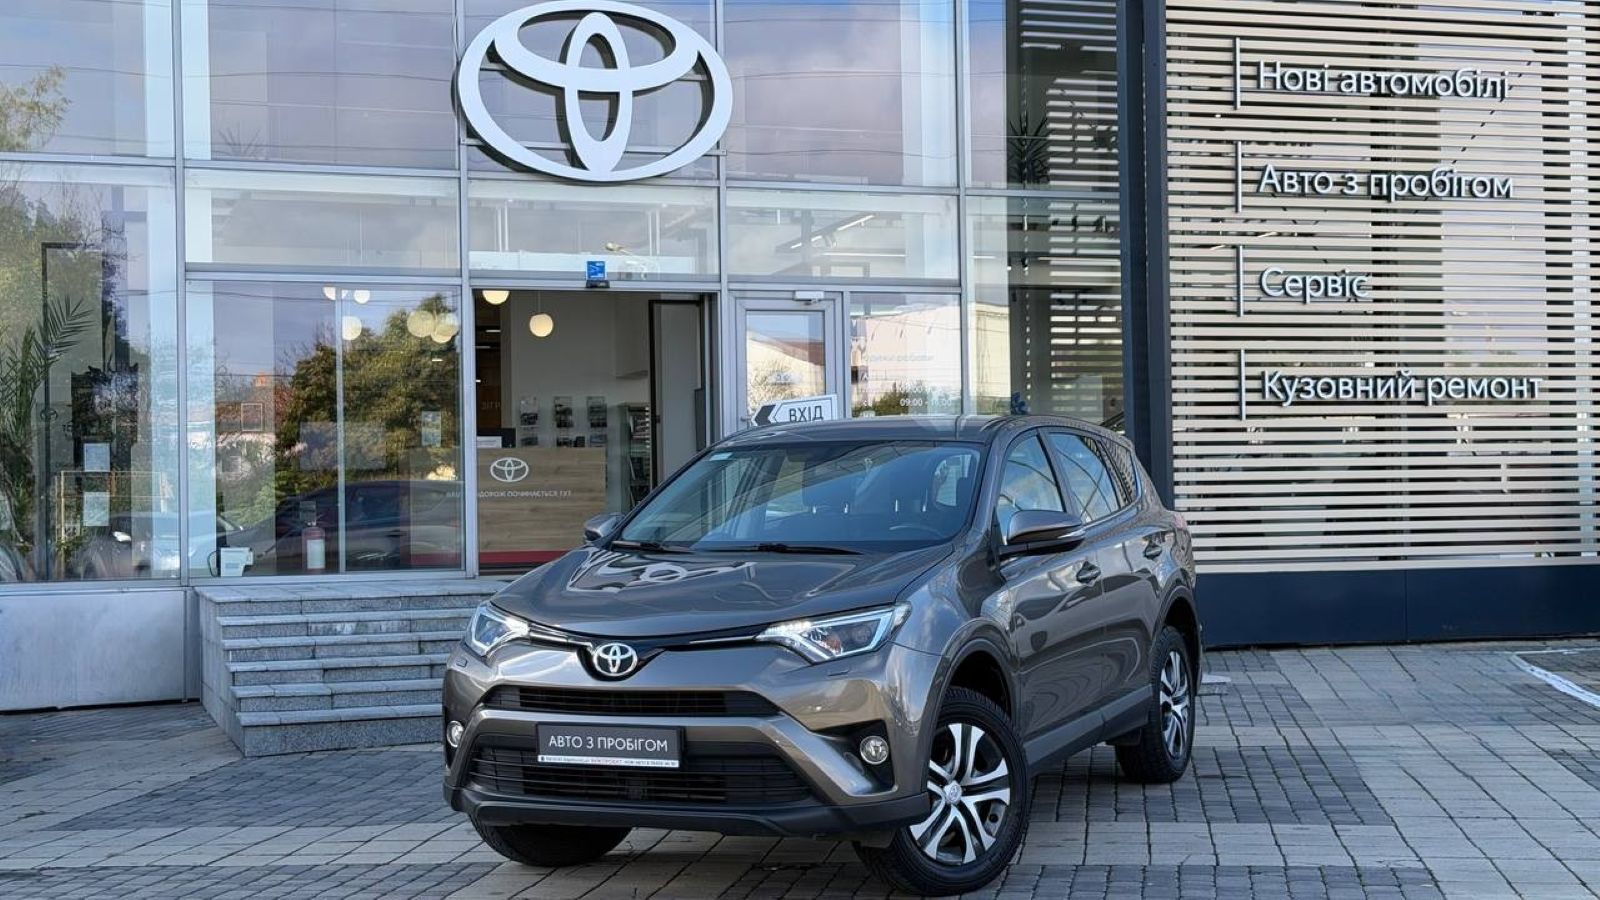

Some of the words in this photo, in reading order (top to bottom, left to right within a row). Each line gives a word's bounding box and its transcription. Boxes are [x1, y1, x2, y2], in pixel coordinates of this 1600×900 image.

[1257, 60, 1329, 91] Нові
[1340, 67, 1510, 98] автомобілі
[1258, 164, 1333, 194] Авто
[1341, 173, 1357, 194] з
[1370, 168, 1513, 200] пробігом
[1261, 267, 1371, 302] Сервіс
[1262, 369, 1415, 406] Кузовний
[1425, 375, 1543, 405] ремонт
[789, 405, 824, 423] ВХІД
[549, 735, 583, 748] АВТО
[597, 736, 668, 752] ПРОБІГОМ
